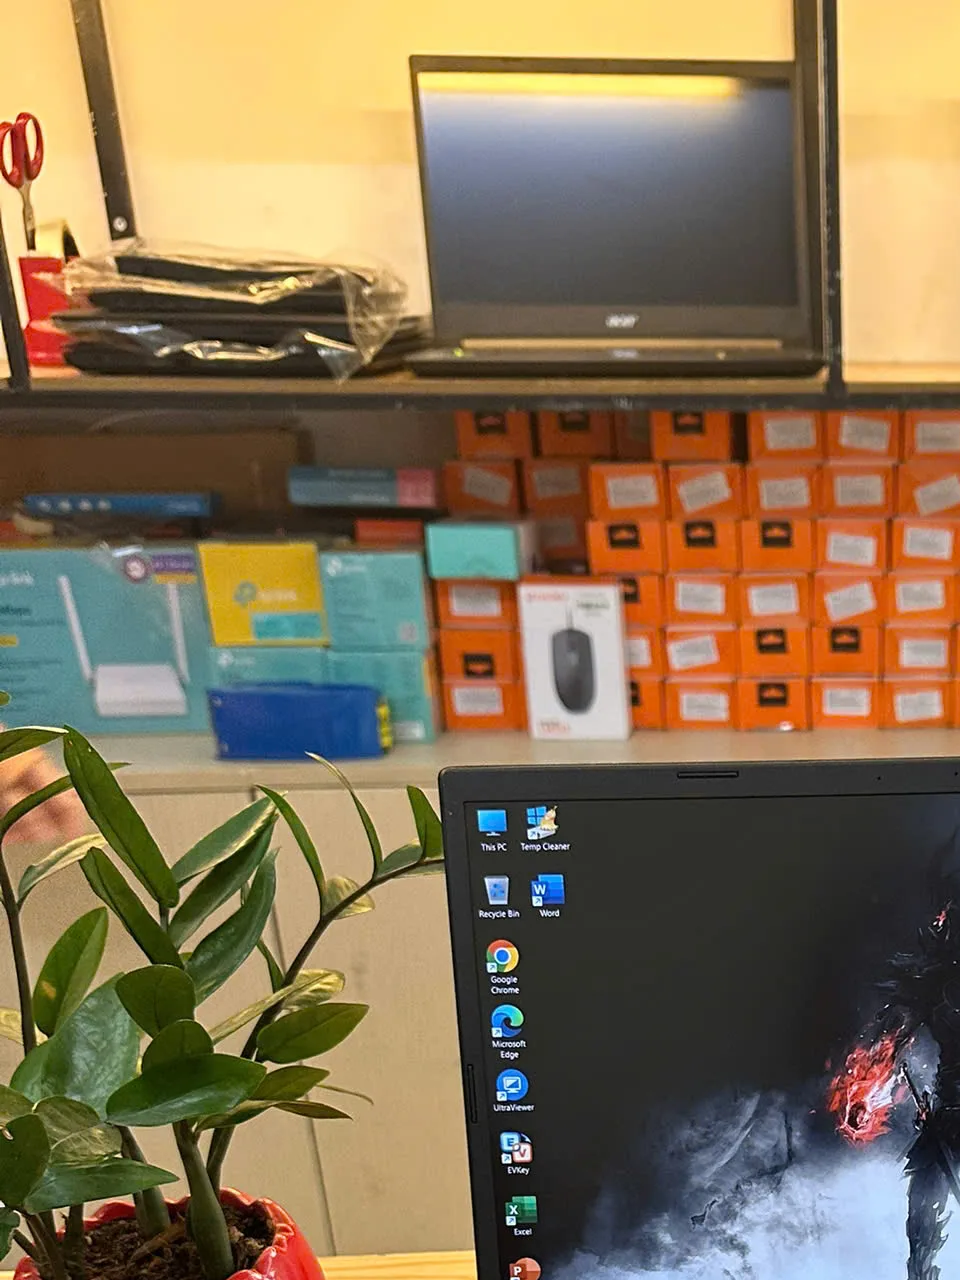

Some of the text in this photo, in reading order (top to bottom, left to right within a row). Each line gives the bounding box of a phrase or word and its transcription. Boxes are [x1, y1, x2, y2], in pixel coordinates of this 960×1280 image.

[481, 843, 496, 851] This
[521, 843, 570, 852] Temp Cleaner
[479, 910, 506, 919] Recycle
[490, 976, 518, 985] Google
[492, 1040, 527, 1048] Microsoft
[500, 1051, 519, 1060] Edge
[493, 1104, 534, 1112] UltraViewer
[507, 1167, 530, 1175] EVKey
[514, 1228, 532, 1236] Excel
